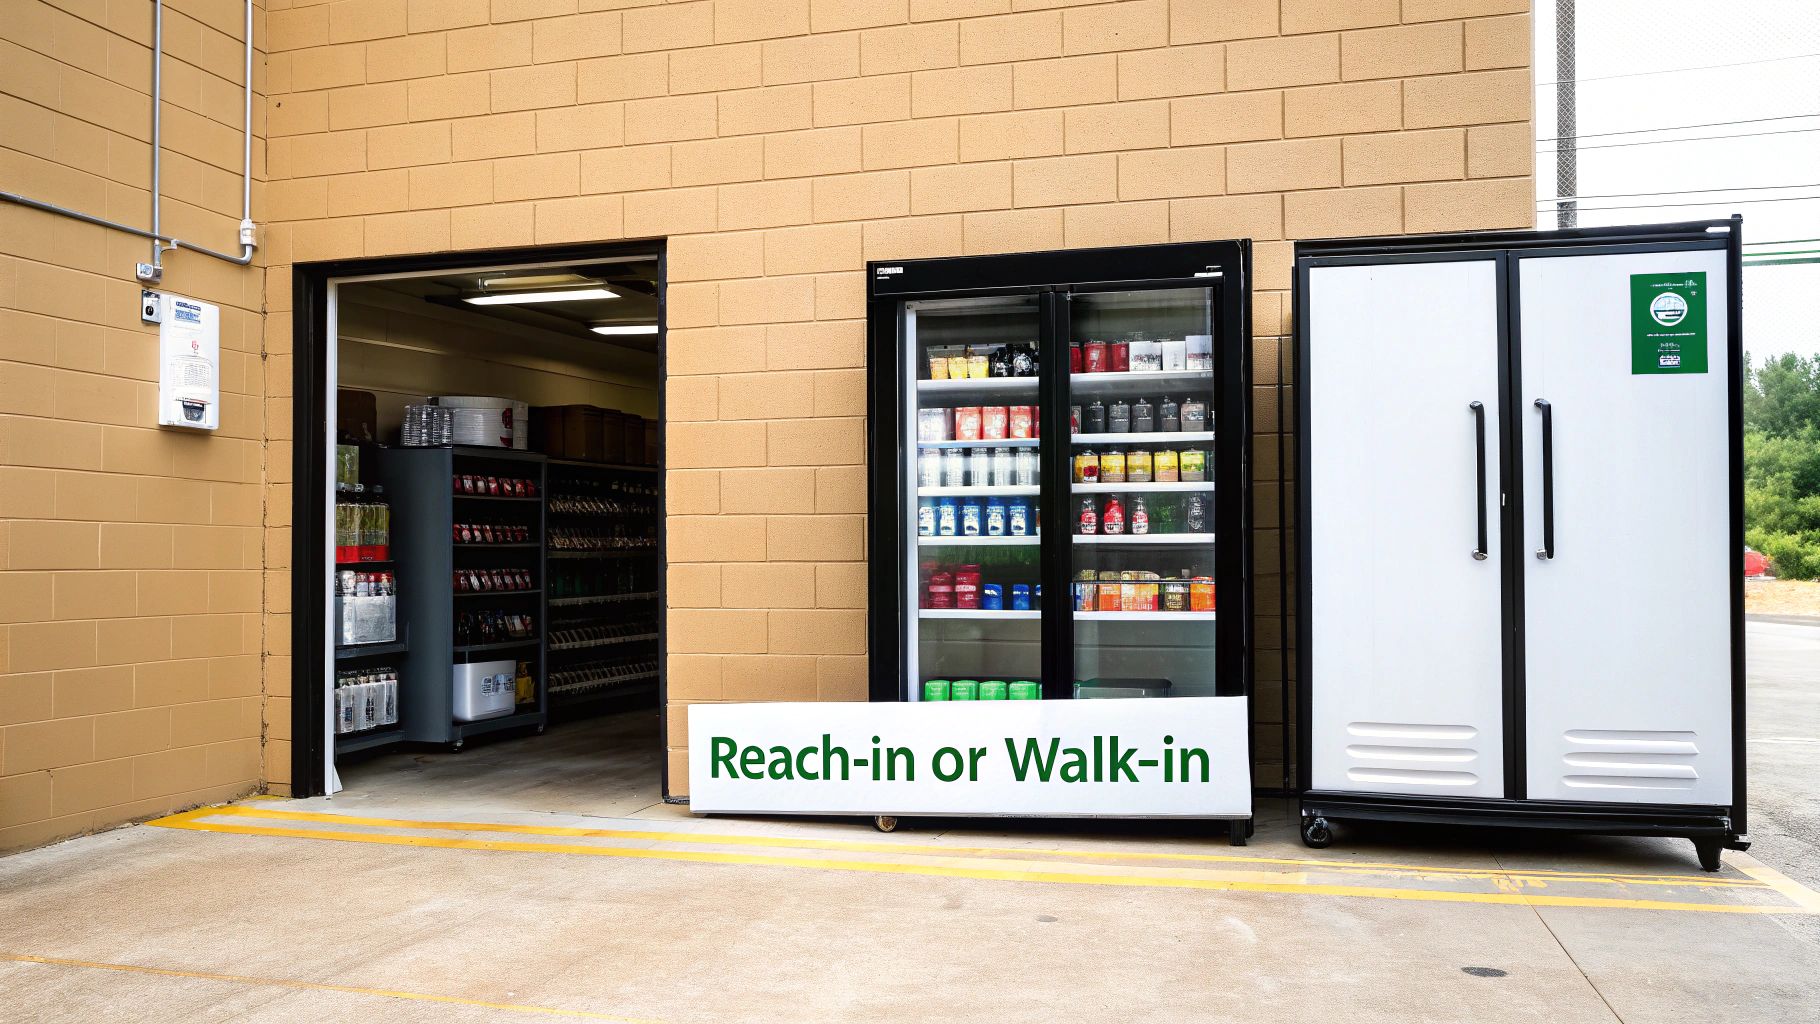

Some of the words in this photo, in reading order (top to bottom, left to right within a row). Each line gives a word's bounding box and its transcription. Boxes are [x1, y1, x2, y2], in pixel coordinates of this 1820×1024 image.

[711, 734, 915, 782] Reach-in
[931, 746, 987, 782] or
[1005, 735, 1210, 783] Walk-in
